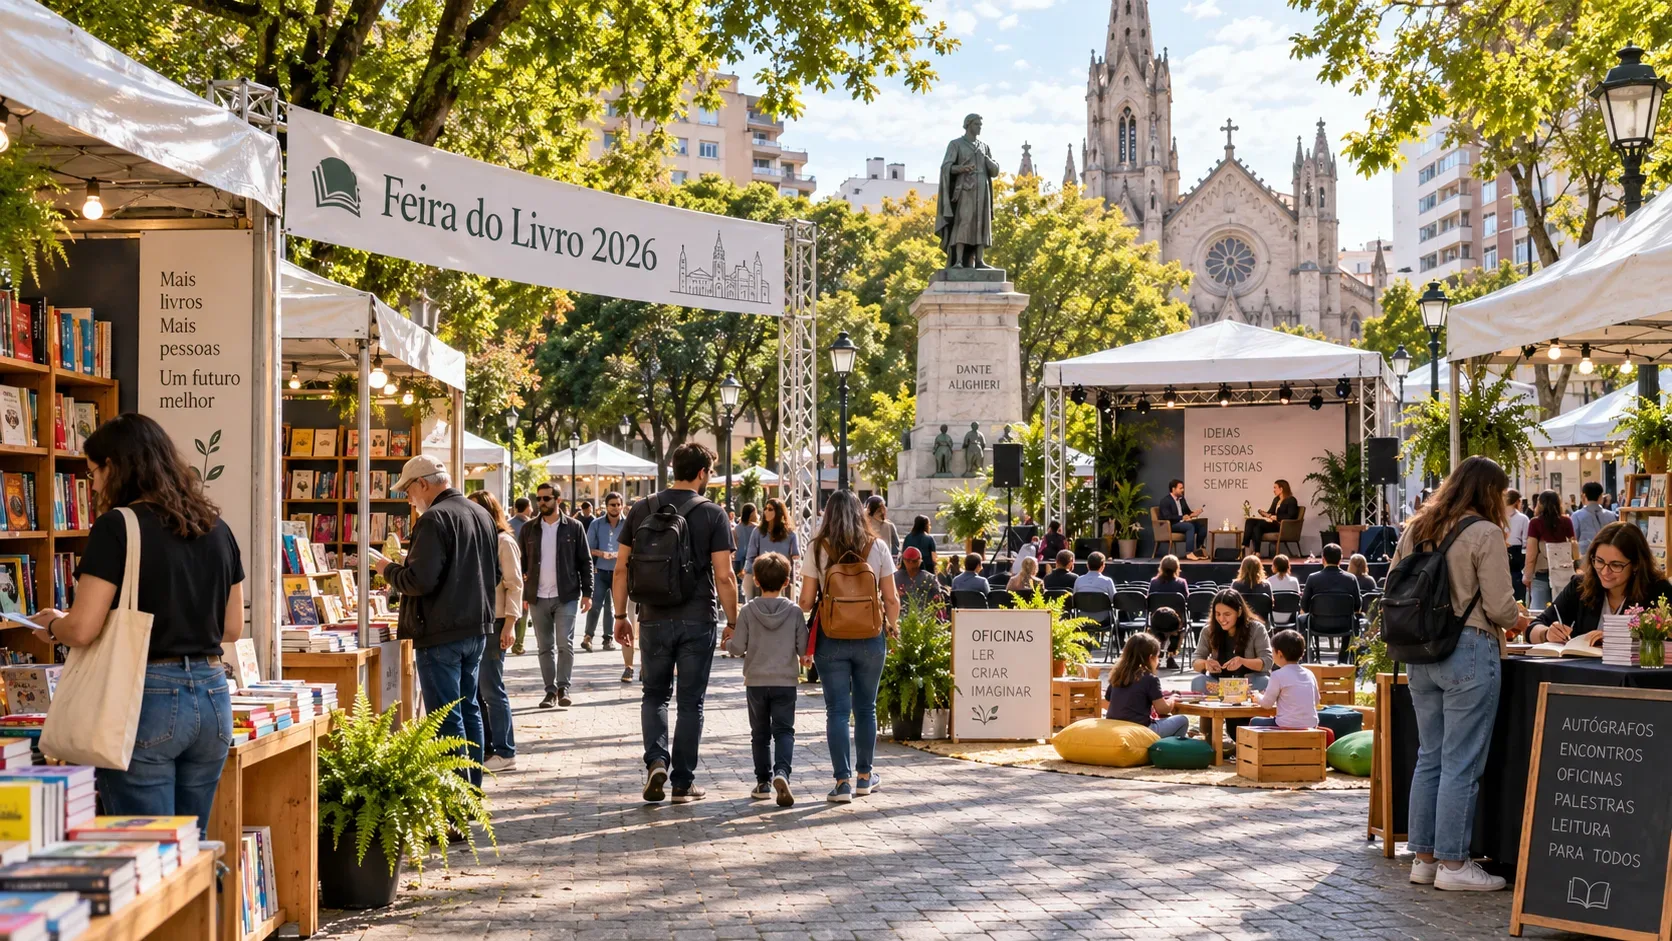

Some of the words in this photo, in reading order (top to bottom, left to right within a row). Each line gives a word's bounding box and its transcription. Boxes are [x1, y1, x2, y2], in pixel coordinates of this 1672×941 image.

[381, 174, 457, 232] Feira
[466, 198, 502, 241] do
[511, 208, 583, 257] Livro
[592, 227, 657, 270] 2026
[160, 270, 196, 287] Mais
[160, 293, 203, 310] livros
[160, 317, 197, 334] Mais
[159, 343, 221, 361] pessoas
[159, 369, 188, 387] Um
[192, 368, 241, 386] futuro
[956, 364, 993, 375] DANTE
[948, 379, 1000, 390] ALIGHIERI
[159, 391, 216, 409] melhor
[1203, 427, 1241, 439] IDEIAS
[1203, 444, 1254, 456] PESSOAS
[1203, 460, 1263, 473] HISTÓRIAS
[1203, 478, 1249, 490] SEMPRE
[971, 629, 1034, 643] OFICINAS
[971, 648, 995, 661] LER
[971, 666, 1009, 679] CRIAR
[971, 685, 1032, 698] IMAGINAR
[1561, 715, 1654, 738] AUTÓGRAFOS
[1559, 741, 1643, 763] ENCONTROS
[1556, 767, 1623, 787] OFICINAS
[1554, 792, 1635, 815] PALESTRAS
[1551, 817, 1611, 838] LEITURA
[1548, 842, 1585, 861] PARA
[1592, 848, 1641, 868] TODOS
